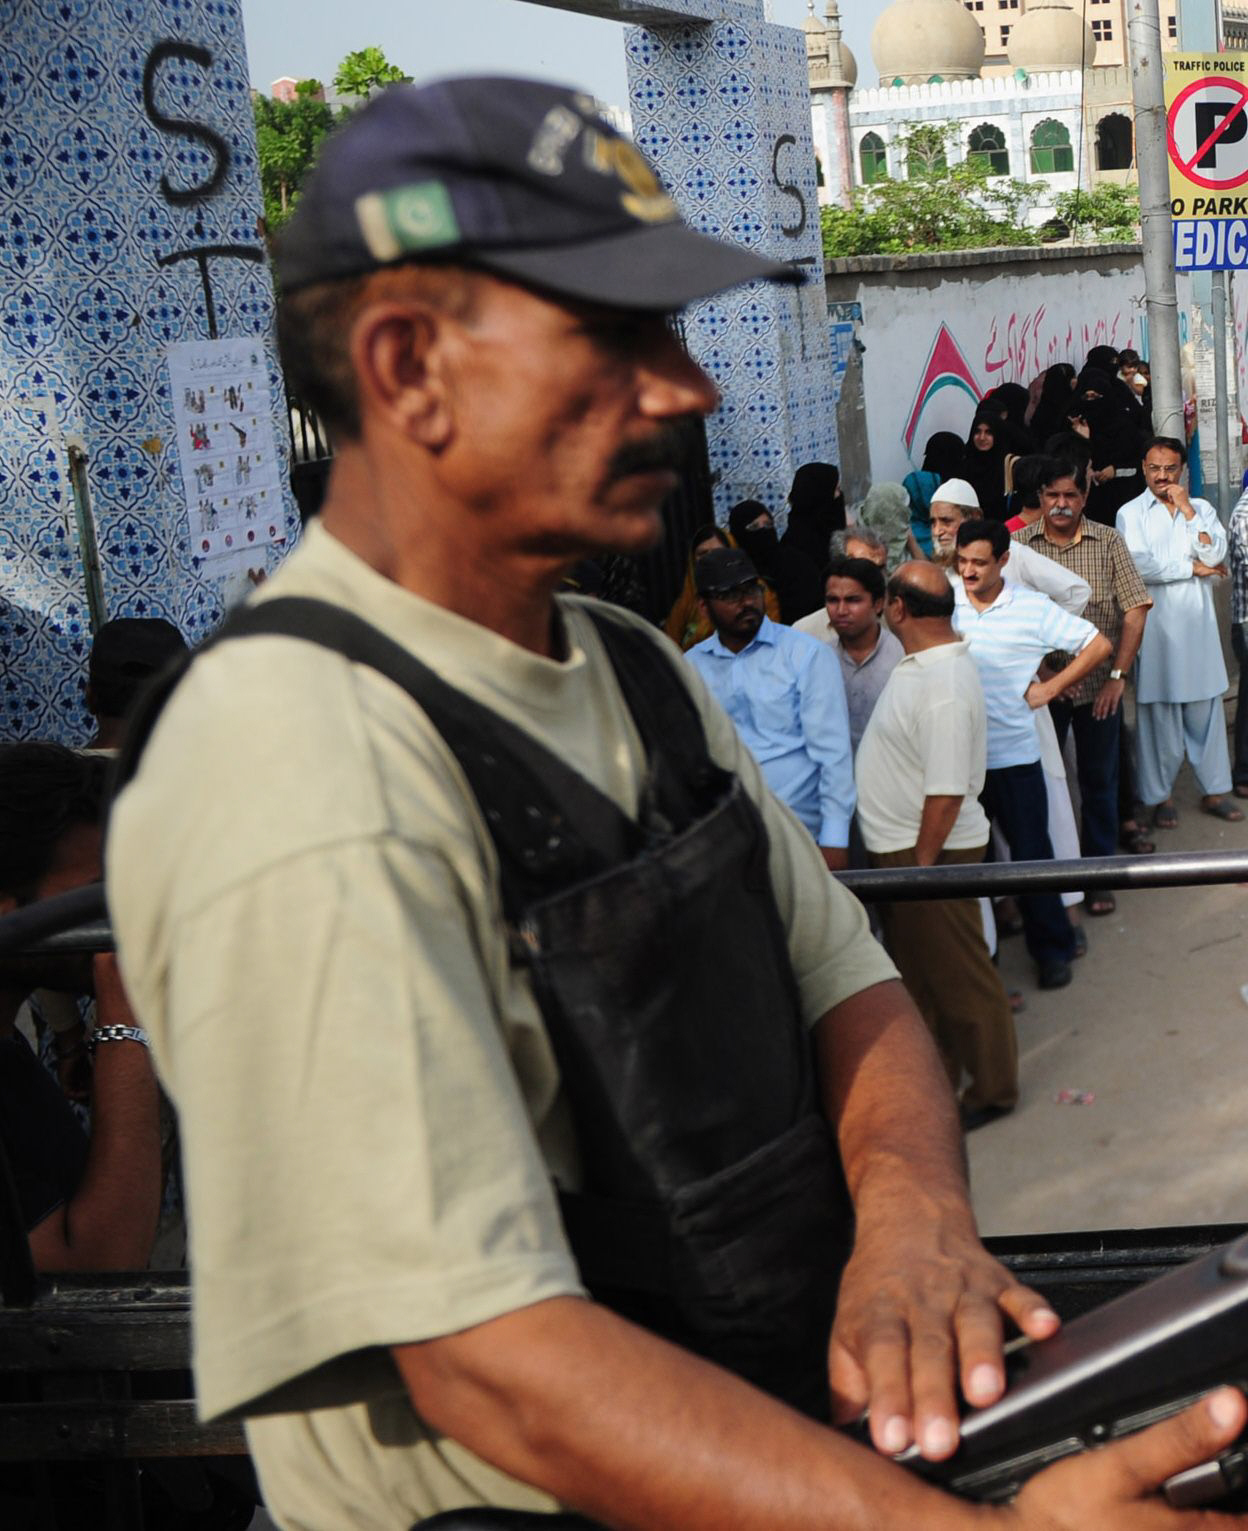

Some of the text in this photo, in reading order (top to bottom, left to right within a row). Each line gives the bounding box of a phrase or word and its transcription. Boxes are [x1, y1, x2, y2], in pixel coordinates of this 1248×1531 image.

[1173, 60, 1211, 72] TRAFFIC
[1213, 61, 1245, 72] POLICE
[1171, 197, 1185, 216] O
